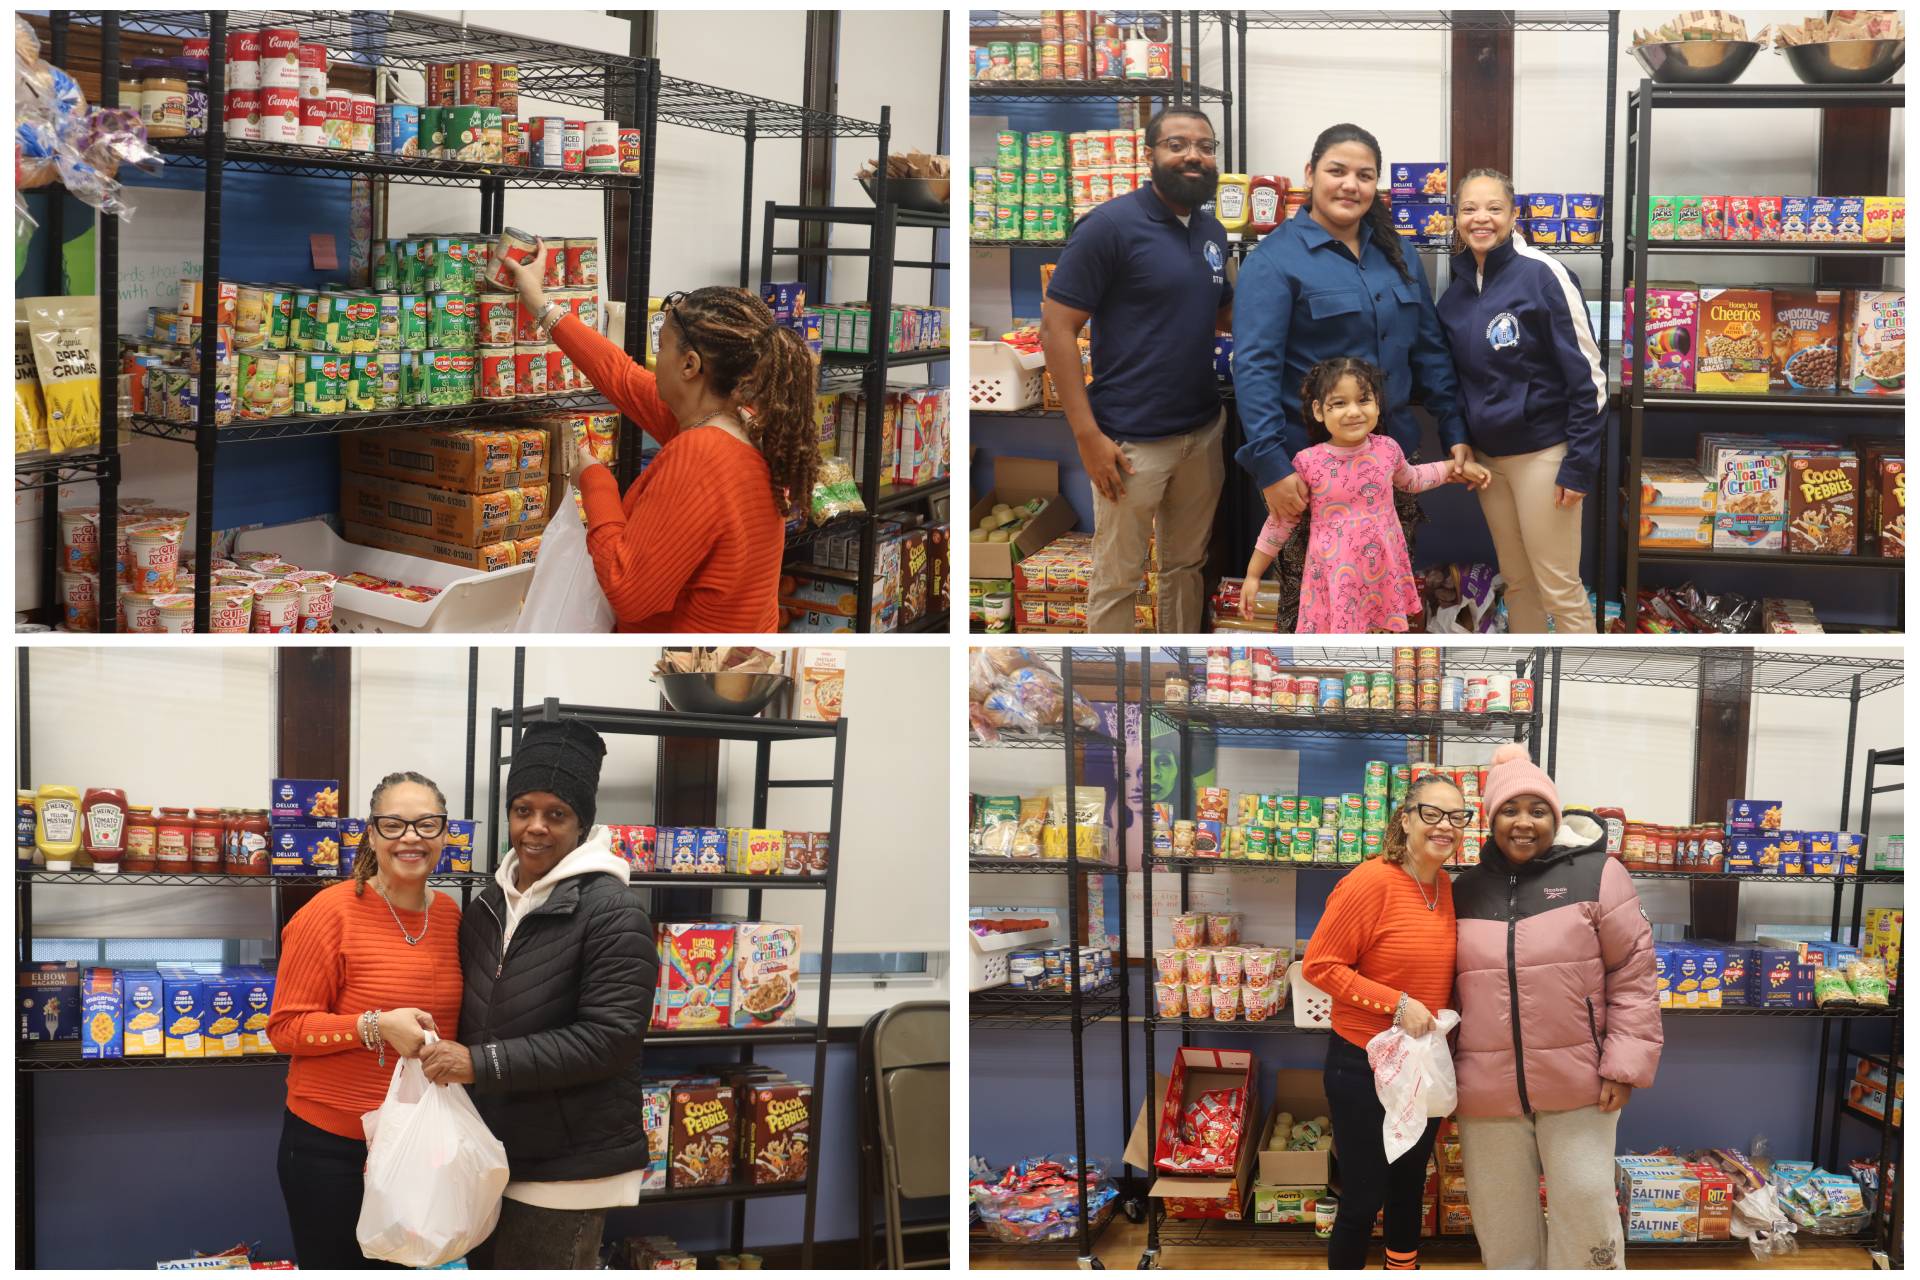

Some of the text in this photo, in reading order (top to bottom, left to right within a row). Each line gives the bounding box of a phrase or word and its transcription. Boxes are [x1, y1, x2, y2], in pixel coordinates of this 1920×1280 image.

[1711, 306, 1761, 321] Cheerios
[1729, 302, 1746, 310] Honey
[1777, 308, 1830, 324] CHOCOLATE
[1790, 319, 1818, 331] PUFFS
[1803, 468, 1847, 485] COCOA
[1800, 479, 1853, 503] PEBBLES
[94, 816, 118, 824] TOMATO
[32, 973, 67, 981] ELBOW
[685, 1099, 723, 1116] COCOA
[768, 1098, 804, 1115] COCOA
[683, 1109, 728, 1136] PEBBLES
[765, 1107, 808, 1133] PEBBLES
[1632, 1187, 1681, 1200] SALTINE
[1708, 1189, 1726, 1203] RITZ
[1630, 1219, 1679, 1231] SALTINE
